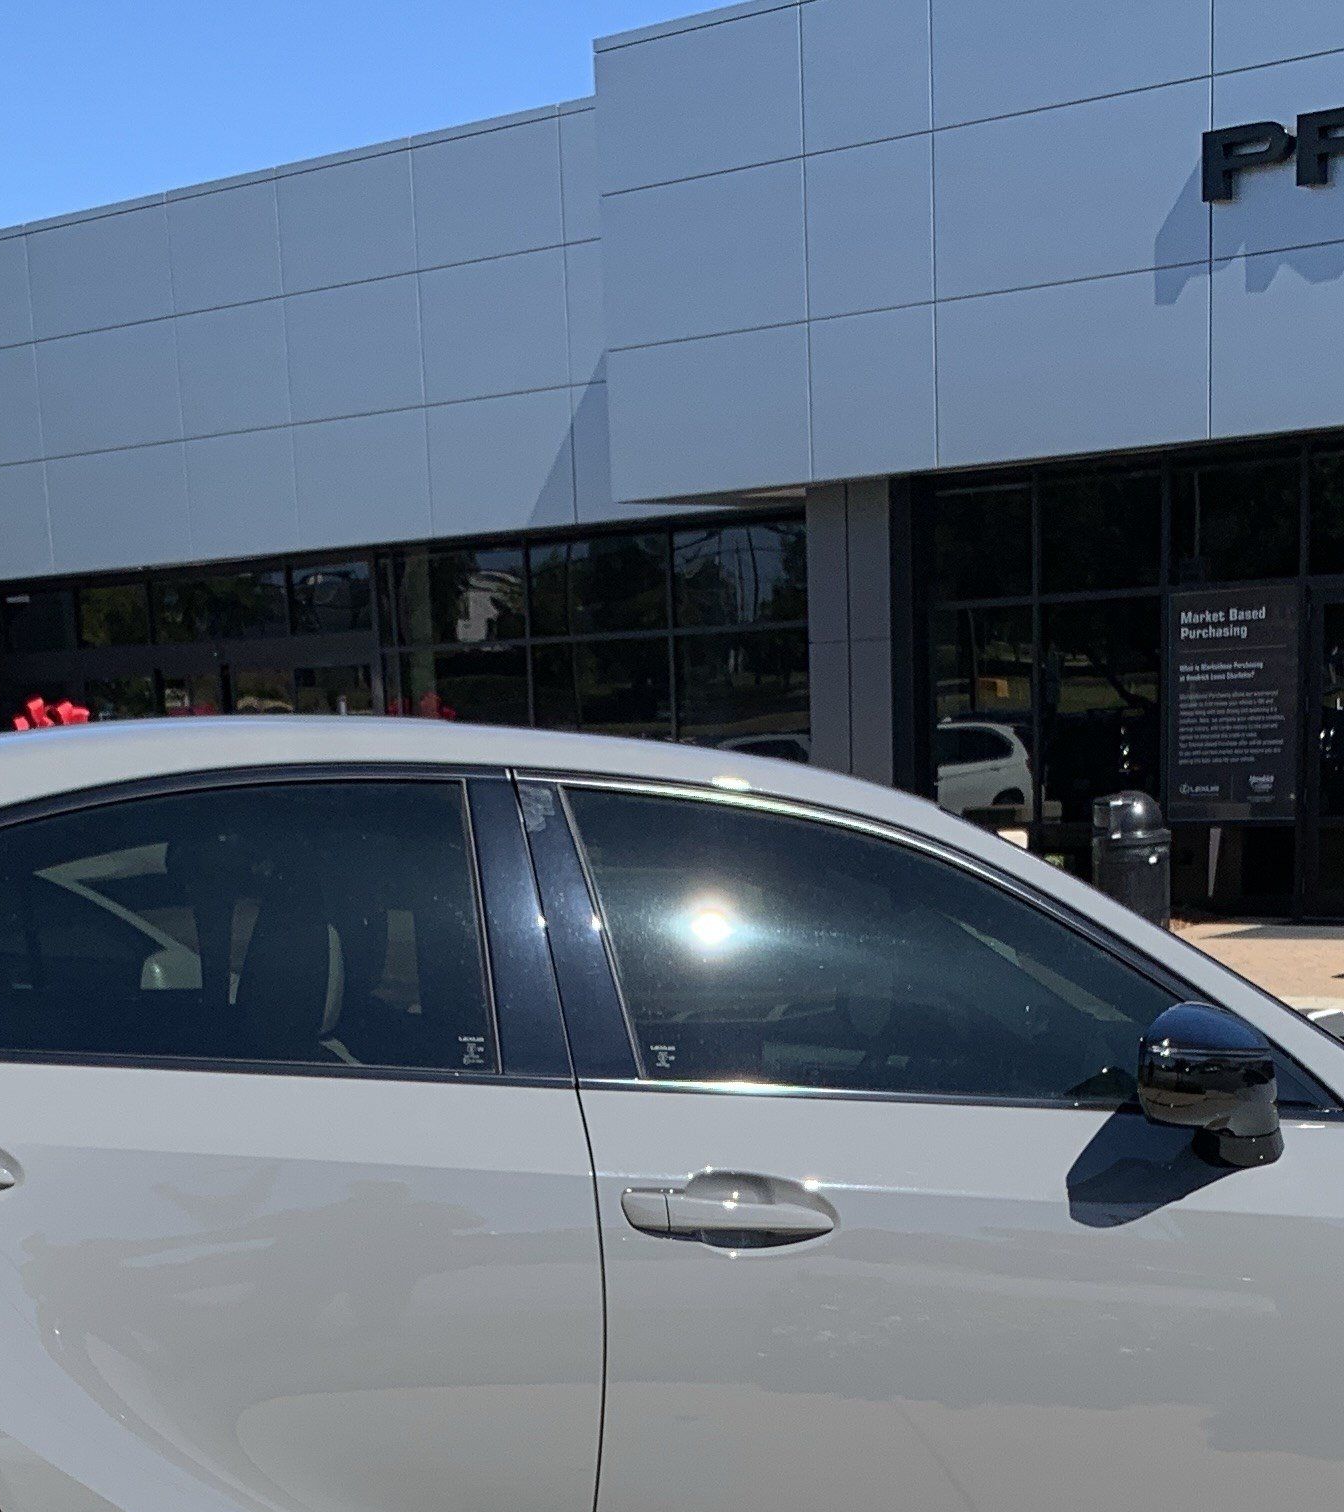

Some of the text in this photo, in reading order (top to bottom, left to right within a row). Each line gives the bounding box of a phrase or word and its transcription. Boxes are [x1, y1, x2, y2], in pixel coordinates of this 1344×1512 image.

[1180, 606, 1266, 625] Market Based
[1180, 624, 1248, 640] Purchasing
